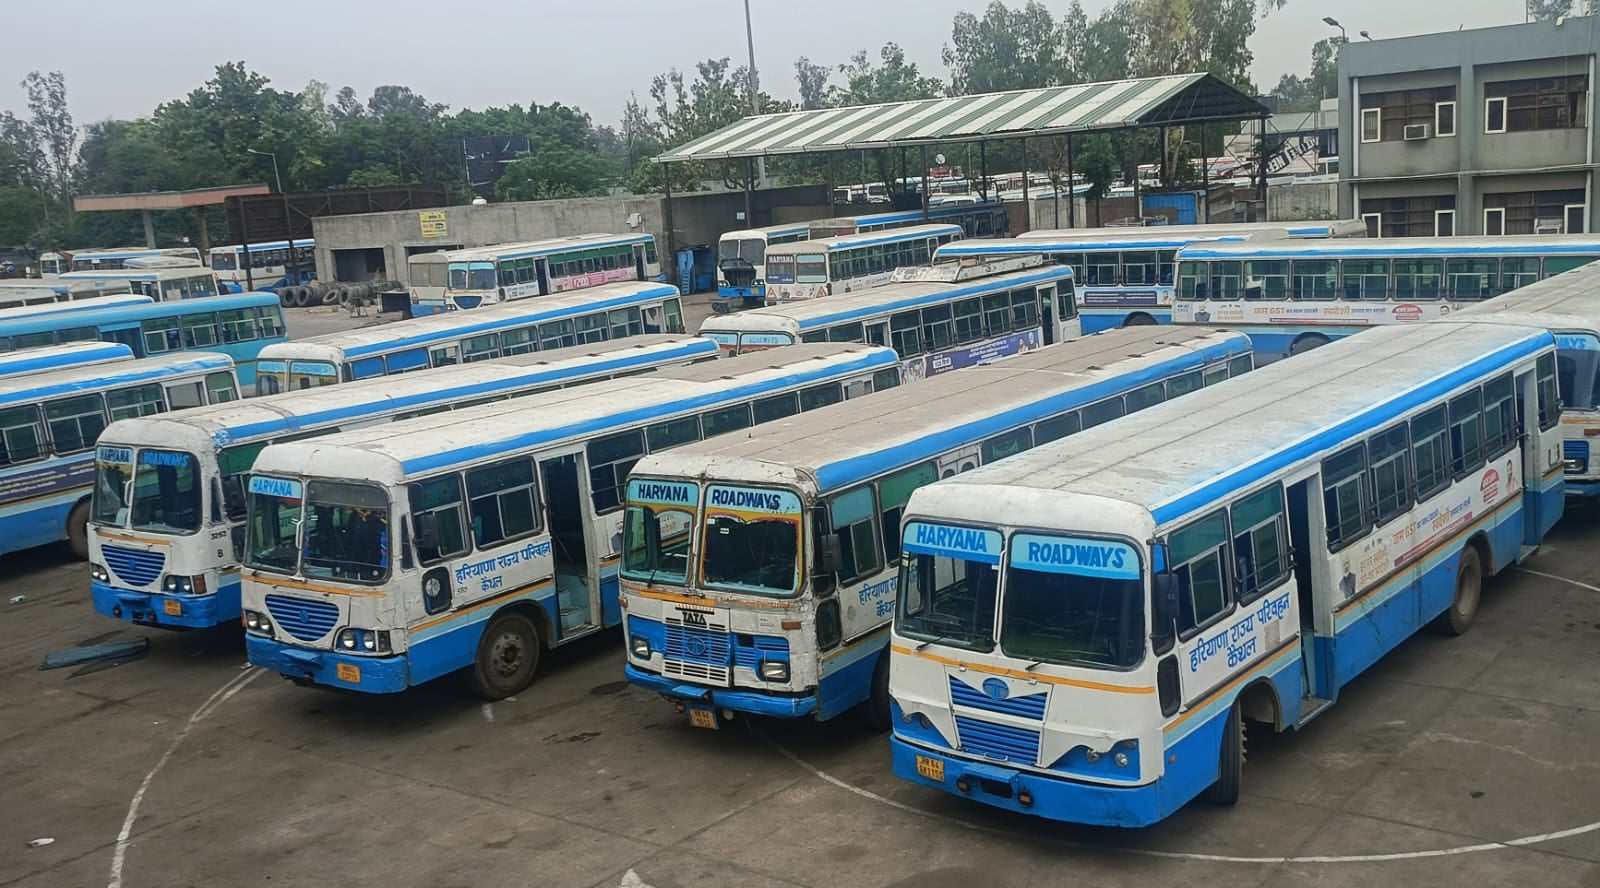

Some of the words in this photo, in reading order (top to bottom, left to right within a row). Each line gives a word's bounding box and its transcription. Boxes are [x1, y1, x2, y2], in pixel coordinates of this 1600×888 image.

[253, 478, 292, 496] HARYANA
[638, 484, 689, 502] HARYANA
[712, 489, 781, 511] ROADWAYS
[917, 525, 987, 552] HARYANA
[1028, 542, 1126, 568] ROADWAYS
[455, 557, 497, 585] हरियाणा
[498, 551, 519, 569] राज्य
[859, 582, 889, 606] हरियाणा
[682, 612, 707, 625] TATA
[1188, 628, 1229, 672] हरियाणा
[1229, 613, 1255, 643] राज्य
[1256, 592, 1290, 625] परिवहन
